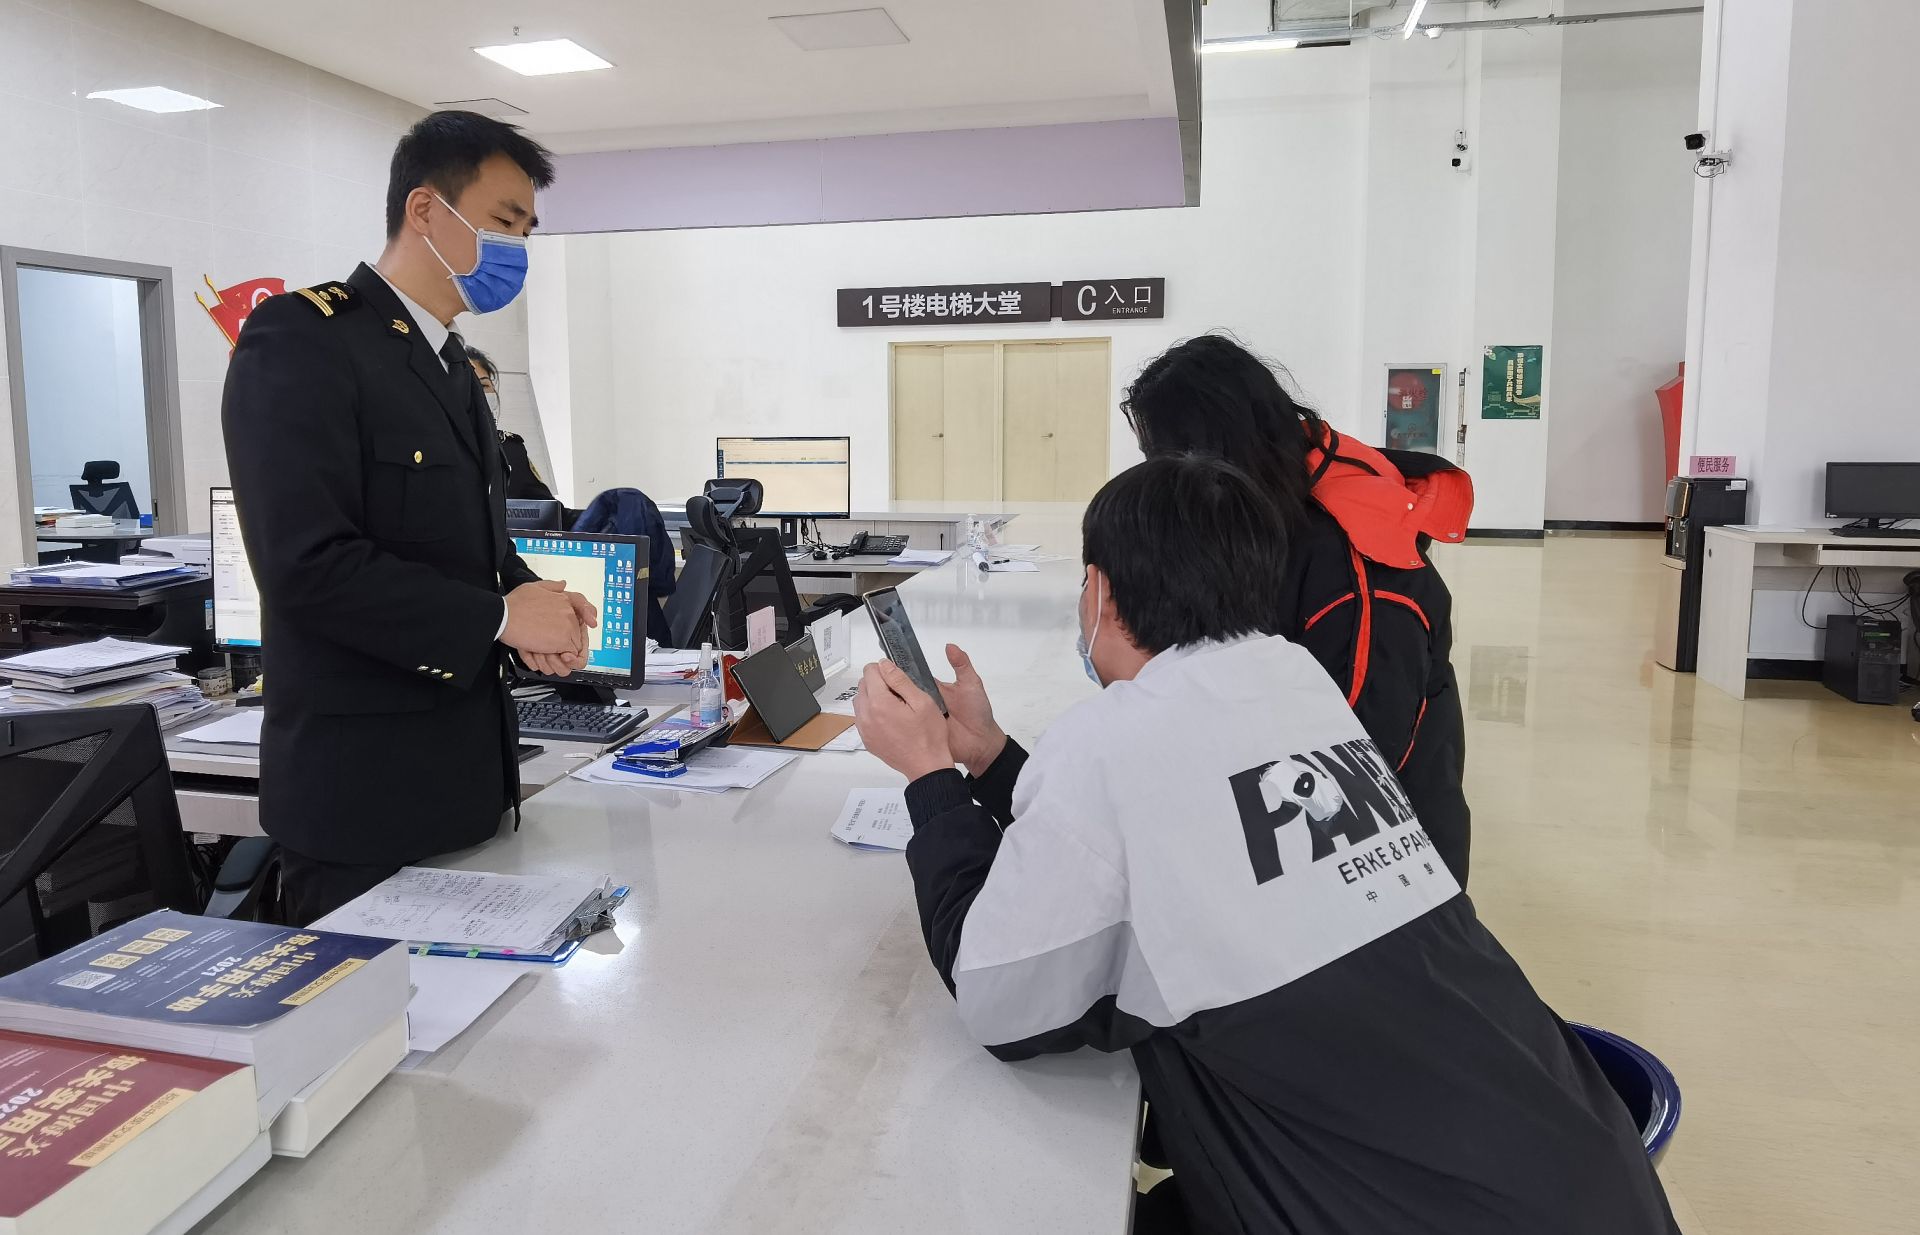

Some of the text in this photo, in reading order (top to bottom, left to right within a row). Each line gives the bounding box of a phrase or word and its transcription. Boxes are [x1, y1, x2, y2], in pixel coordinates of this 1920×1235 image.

[862, 291, 1022, 319] 1号楼电梯大堂
[1077, 284, 1151, 316] C 入口
[1112, 306, 1148, 314] ENTRANCE
[1697, 457, 1730, 473] 便民服务
[166, 934, 321, 1012] 报关实用手册
[200, 956, 243, 977] 2021
[228, 952, 317, 999] 中国海关
[0, 1086, 44, 1121] 202
[8, 1080, 136, 1158] 中国海关
